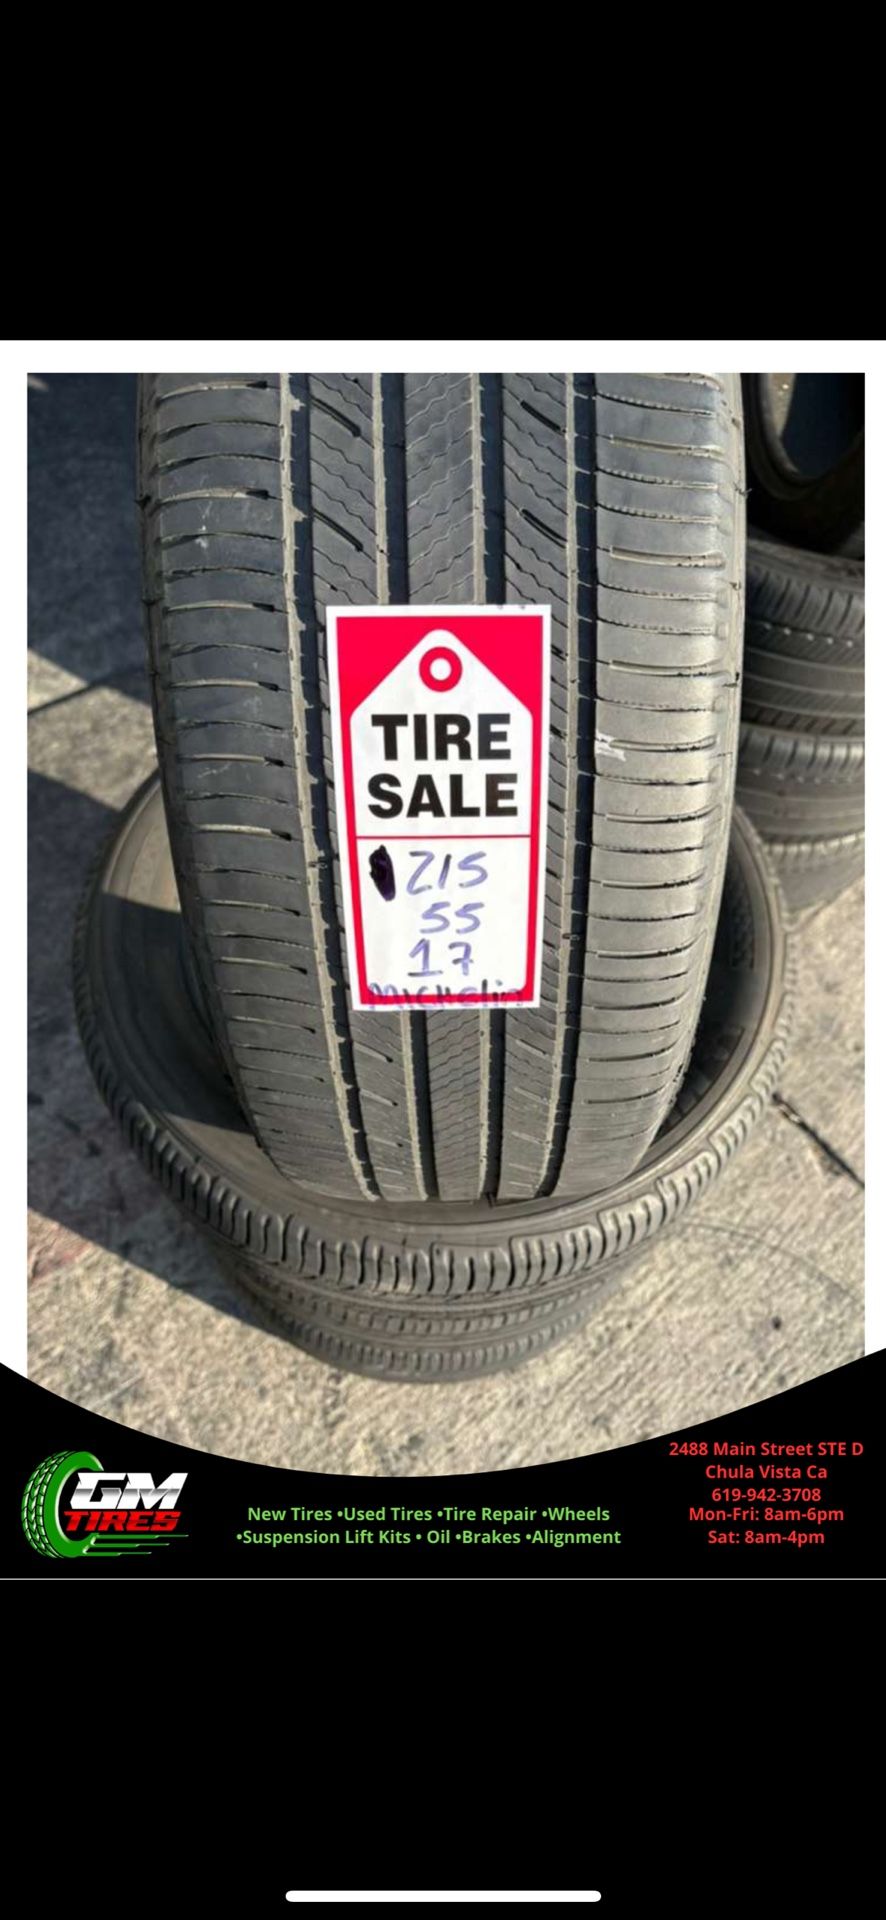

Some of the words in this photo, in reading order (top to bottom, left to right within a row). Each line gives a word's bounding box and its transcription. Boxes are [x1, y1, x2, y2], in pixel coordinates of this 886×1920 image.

[371, 713, 511, 761] TIRE
[368, 773, 518, 819] SALE
[406, 850, 488, 895] 215
[420, 901, 485, 934] 55
[407, 938, 474, 977] 17
